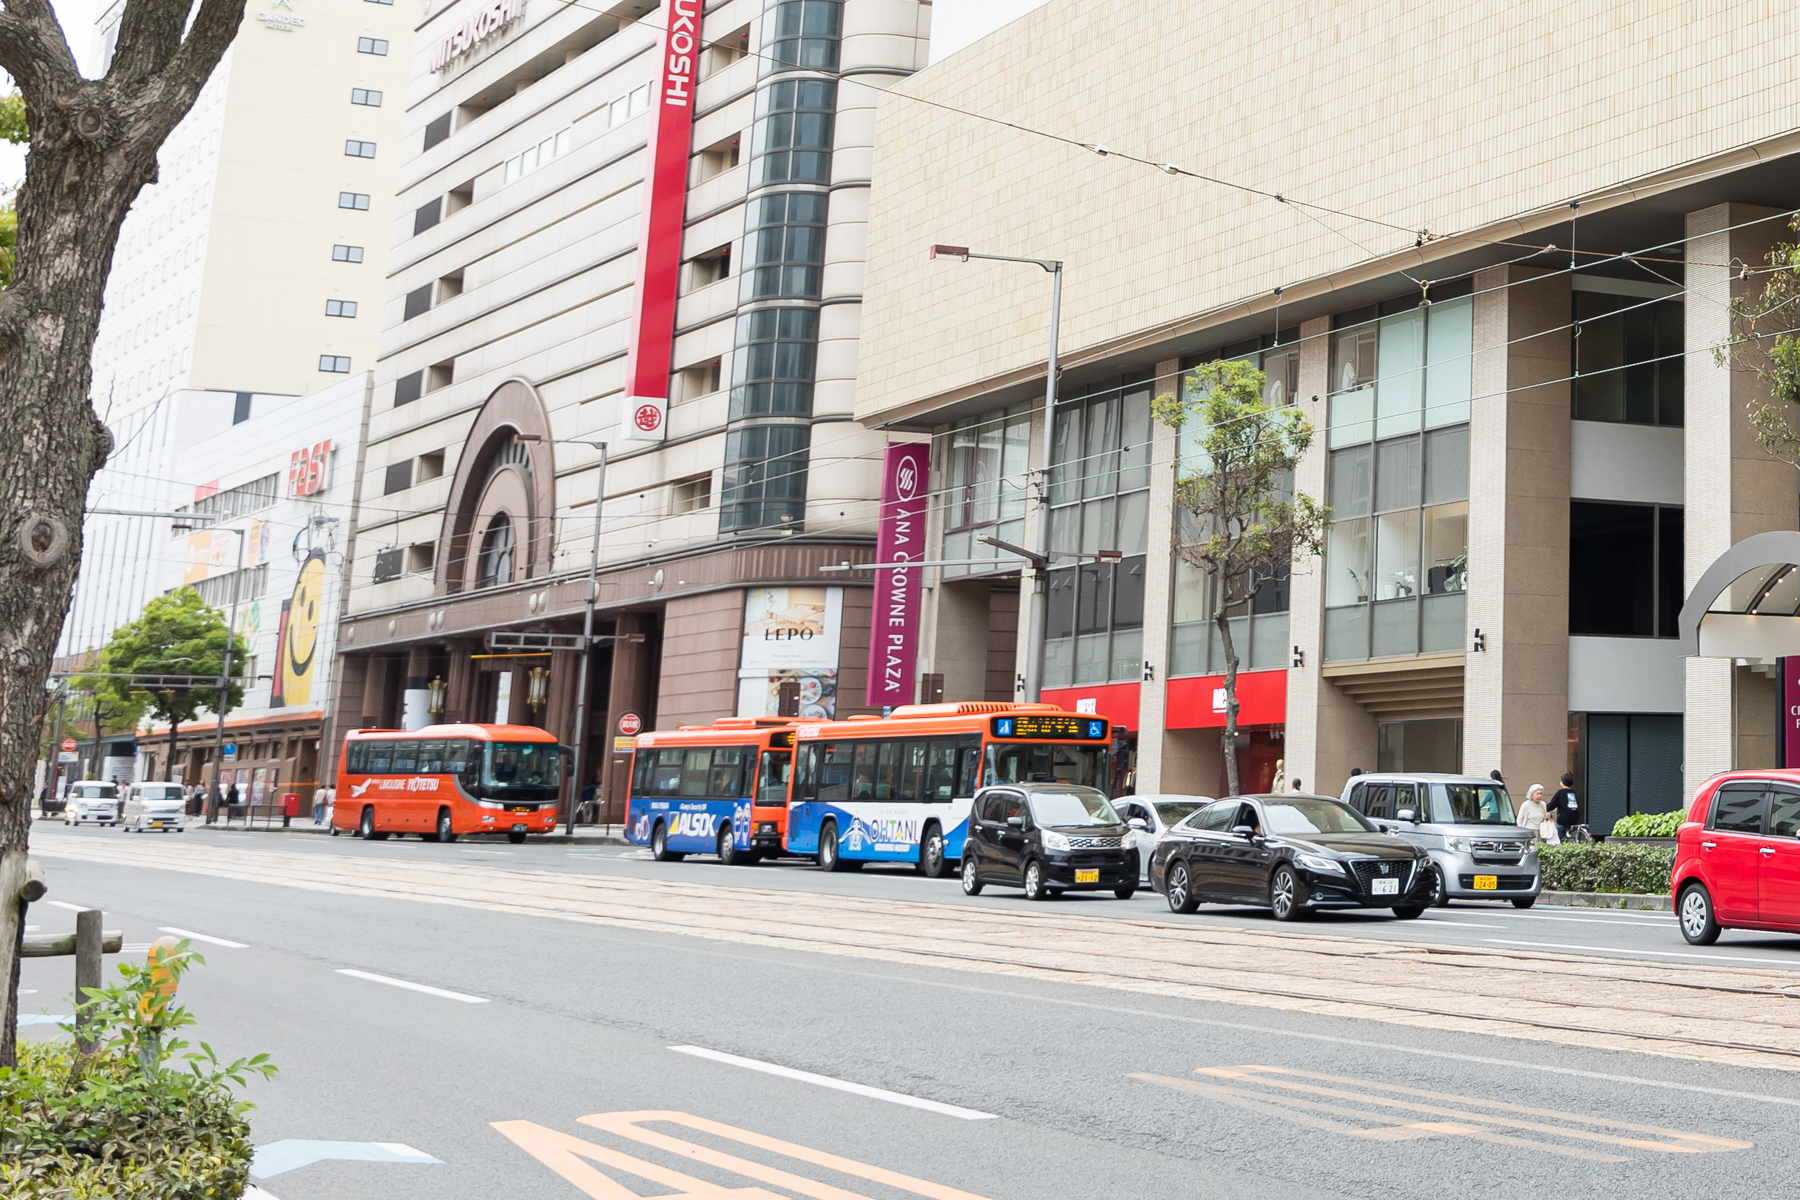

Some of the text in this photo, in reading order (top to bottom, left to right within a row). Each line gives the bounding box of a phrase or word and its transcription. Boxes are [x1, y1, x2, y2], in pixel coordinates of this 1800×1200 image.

[256, 12, 307, 27] CANDEO
[894, 507, 911, 545] ANA
[889, 551, 909, 627] CROWNE
[677, 812, 718, 837] ALSOK
[870, 818, 918, 842] OHTANI
